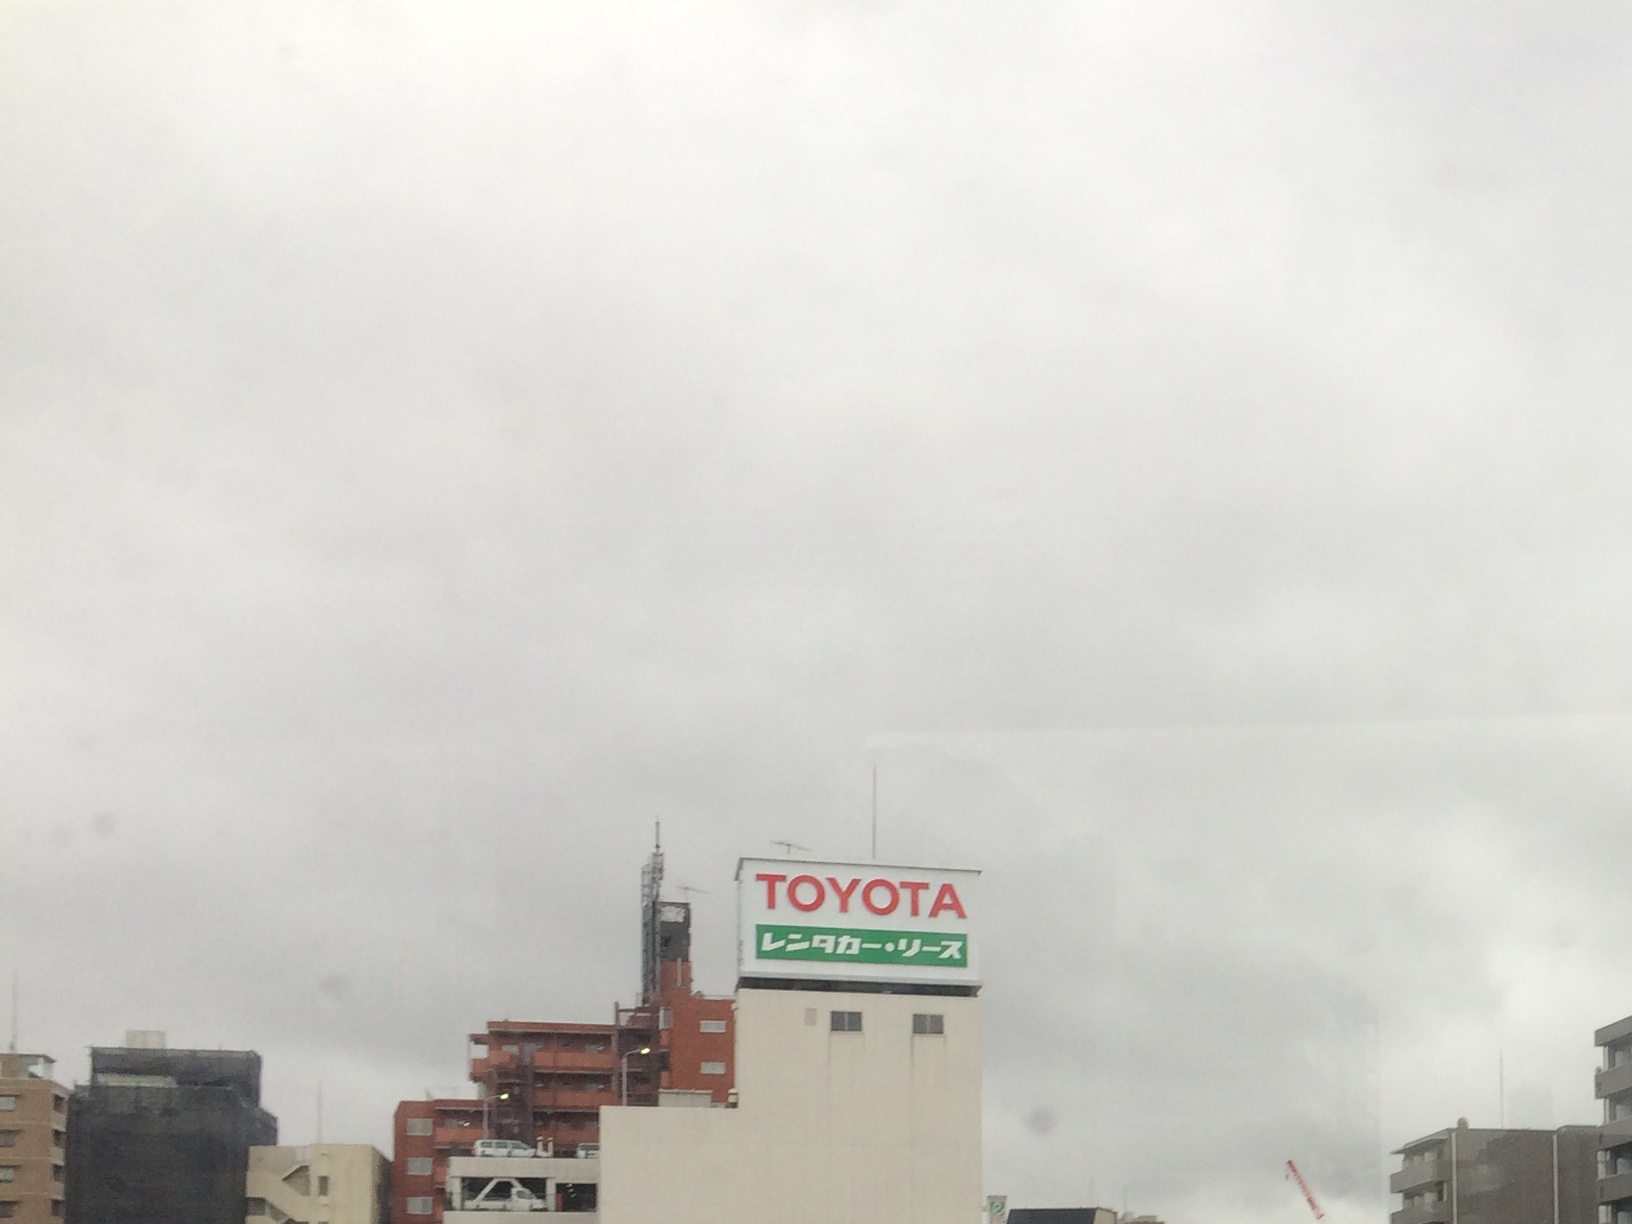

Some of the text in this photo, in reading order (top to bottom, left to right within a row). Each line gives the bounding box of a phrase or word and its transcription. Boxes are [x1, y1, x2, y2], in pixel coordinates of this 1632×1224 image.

[755, 873, 968, 919] TOYOTA
[761, 932, 963, 959] レンタカー・リース
